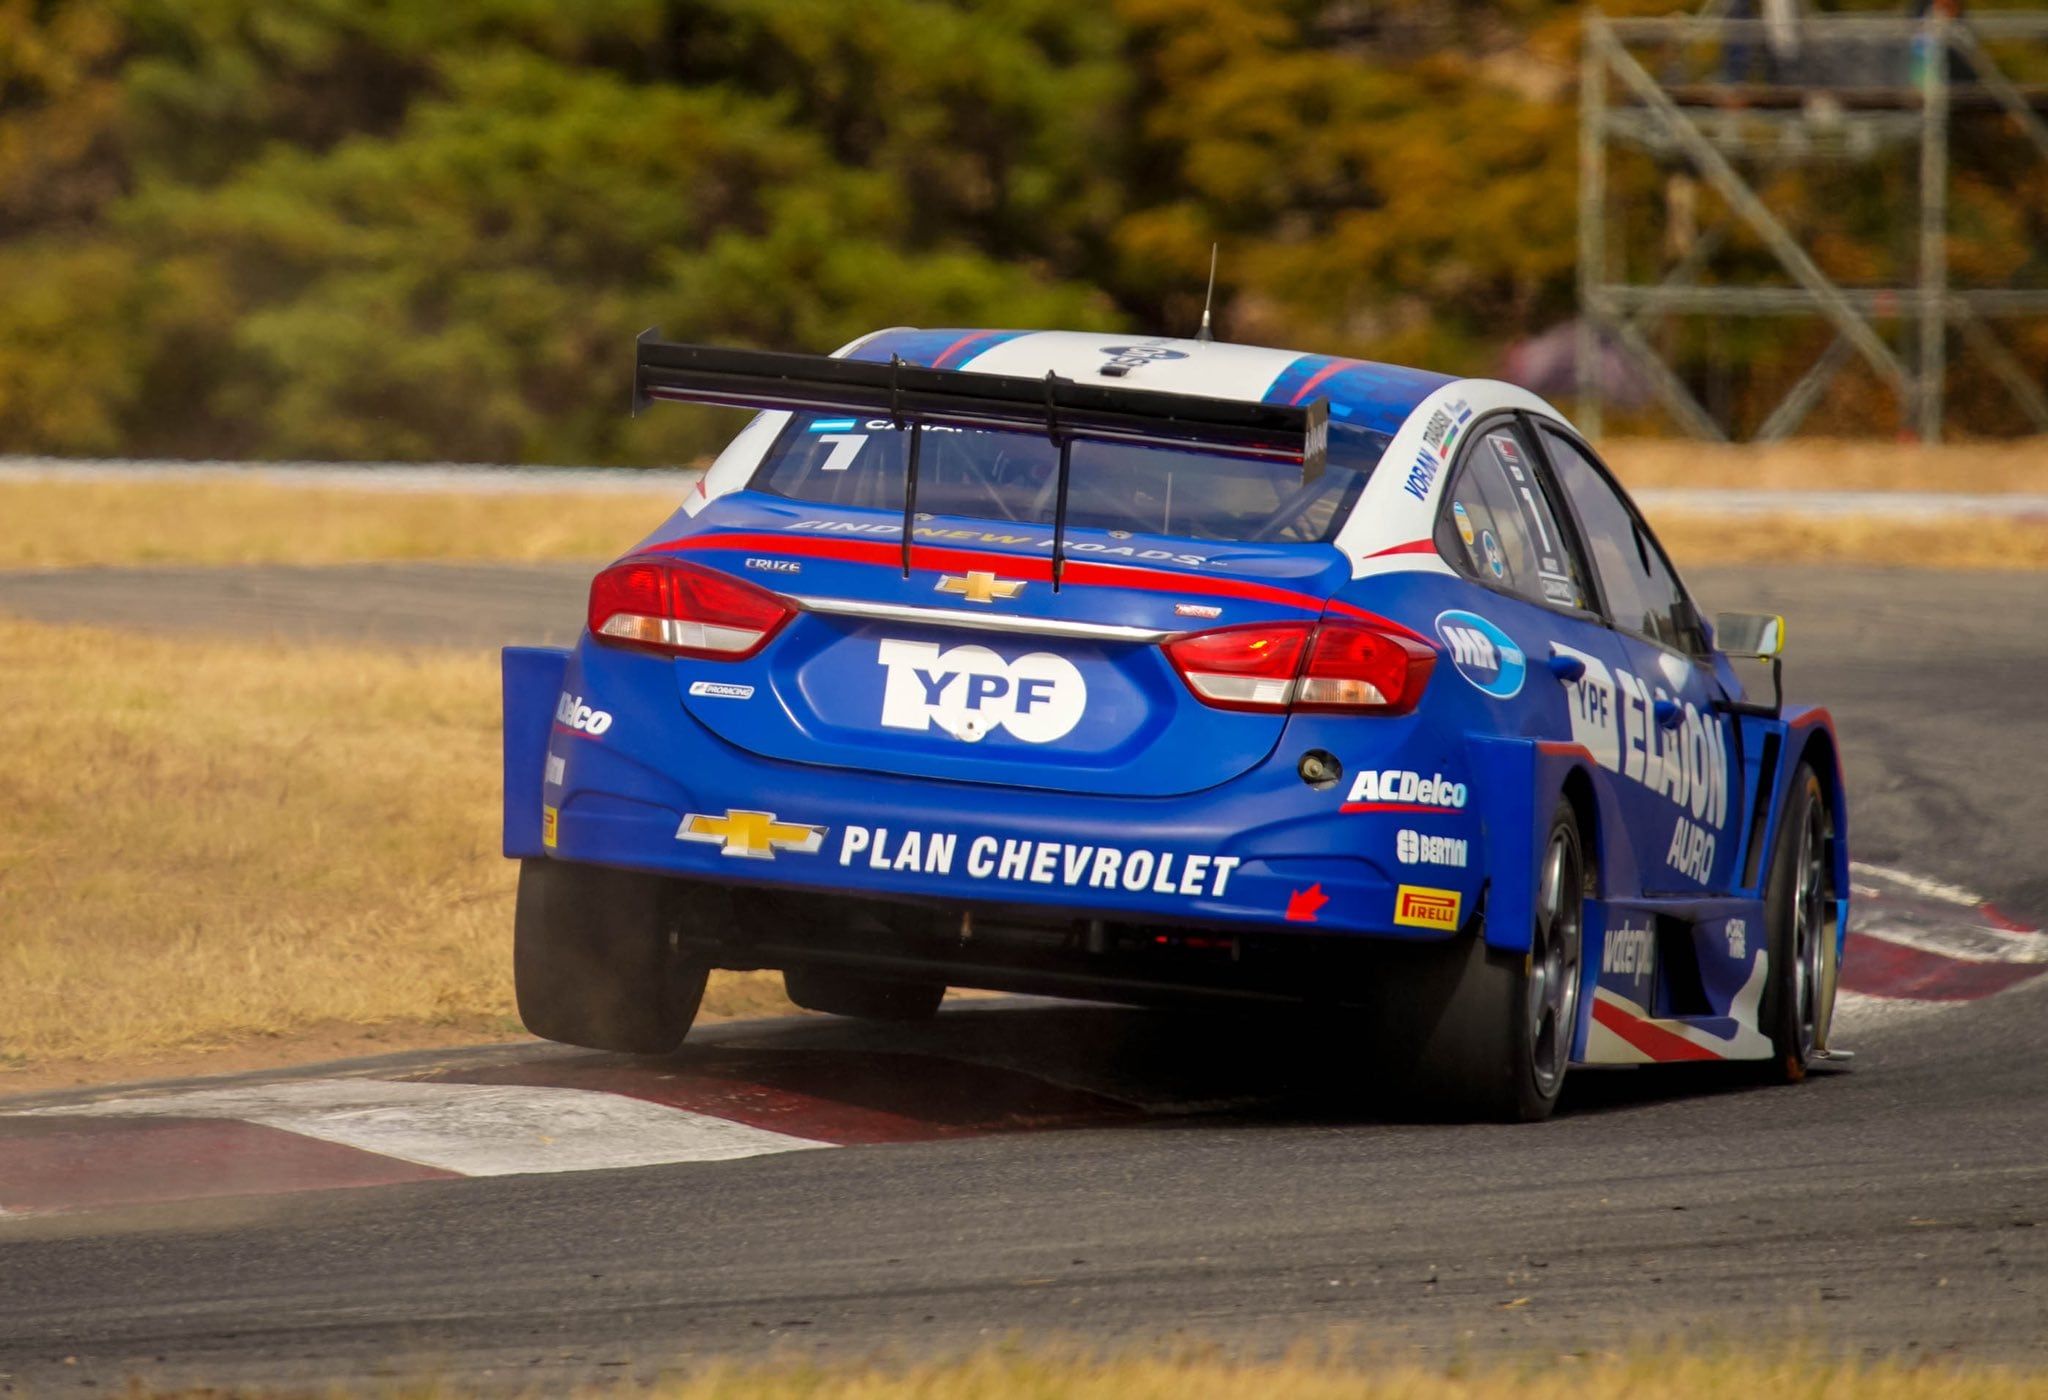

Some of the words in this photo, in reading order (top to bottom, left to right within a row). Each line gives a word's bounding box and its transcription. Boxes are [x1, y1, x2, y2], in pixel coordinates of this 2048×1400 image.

[818, 434, 869, 470] 1
[1404, 447, 1440, 501] VORAN
[912, 527, 1033, 545] NEW
[745, 558, 801, 572] CRUZE
[912, 668, 1056, 714] YPF
[1576, 680, 1609, 729] YPF
[1346, 770, 1467, 808] ACDelco
[839, 825, 957, 875] PLAN
[966, 836, 1240, 897] CHEVROLET
[1666, 816, 1716, 886] AURO
[1402, 893, 1457, 922] PIRELLI
